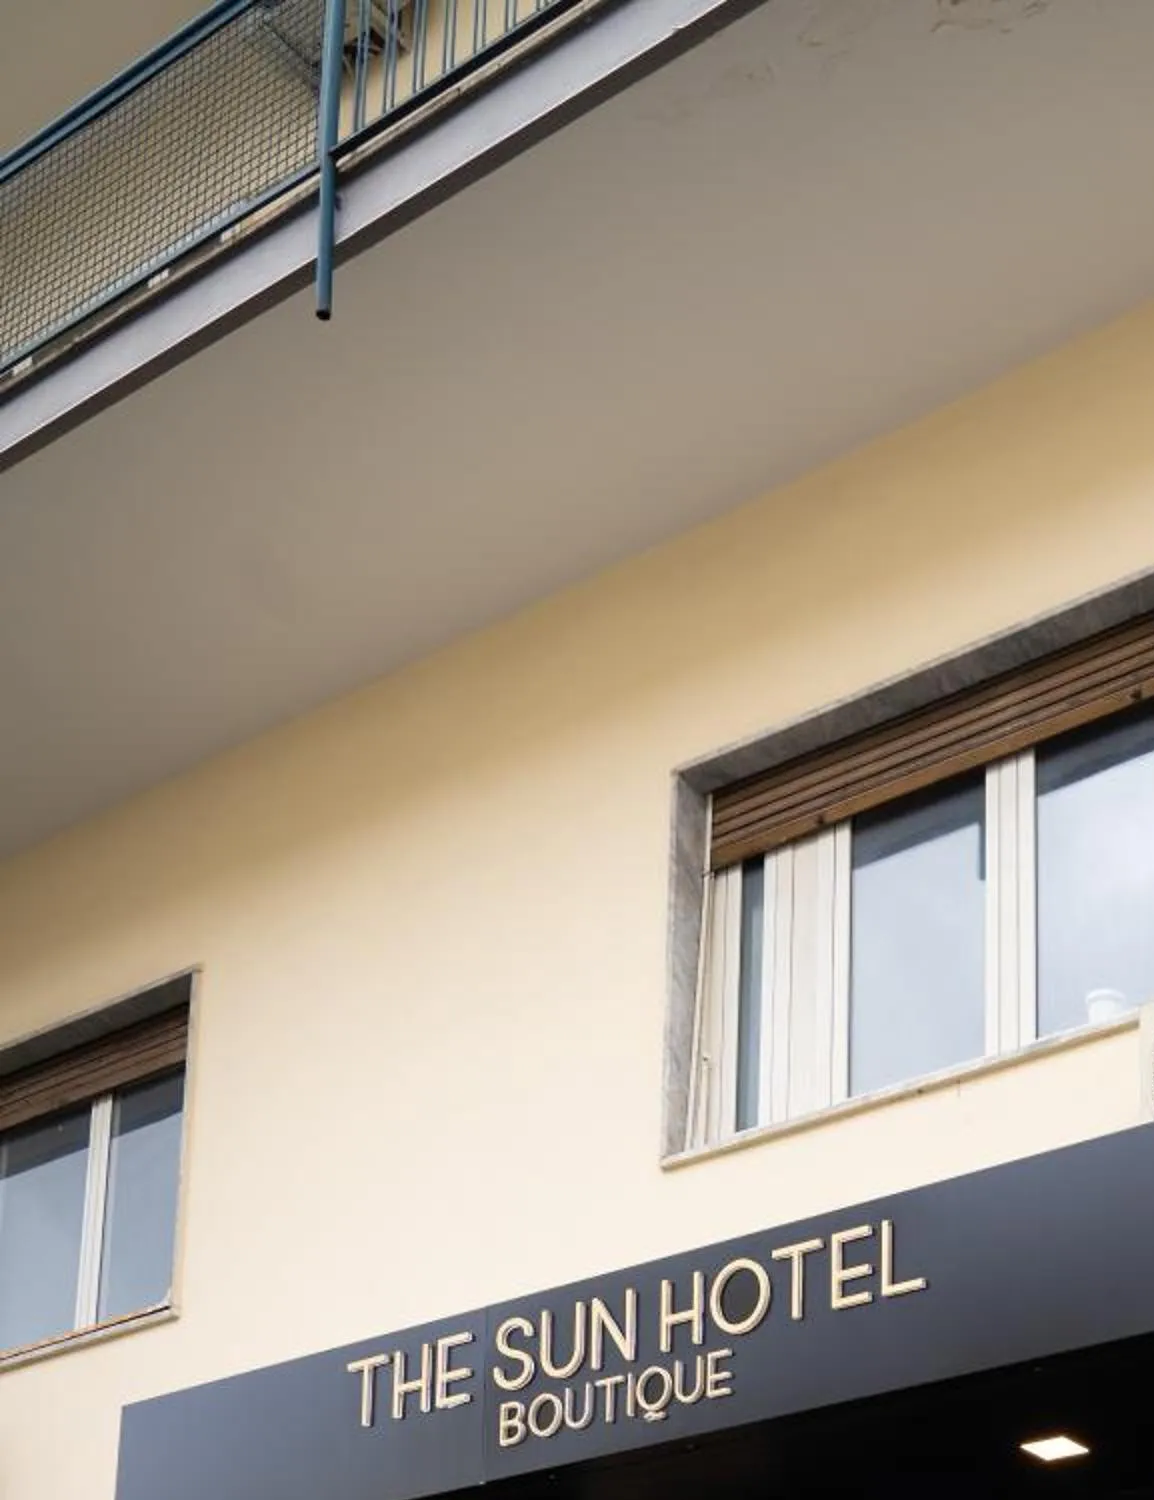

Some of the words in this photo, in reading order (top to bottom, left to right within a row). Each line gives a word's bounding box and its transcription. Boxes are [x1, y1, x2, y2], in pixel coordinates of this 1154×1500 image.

[346, 1331, 475, 1428] THE
[492, 1288, 637, 1391] SUN
[659, 1219, 928, 1353] HOTEL
[499, 1347, 734, 1448] BOUTIQUE
